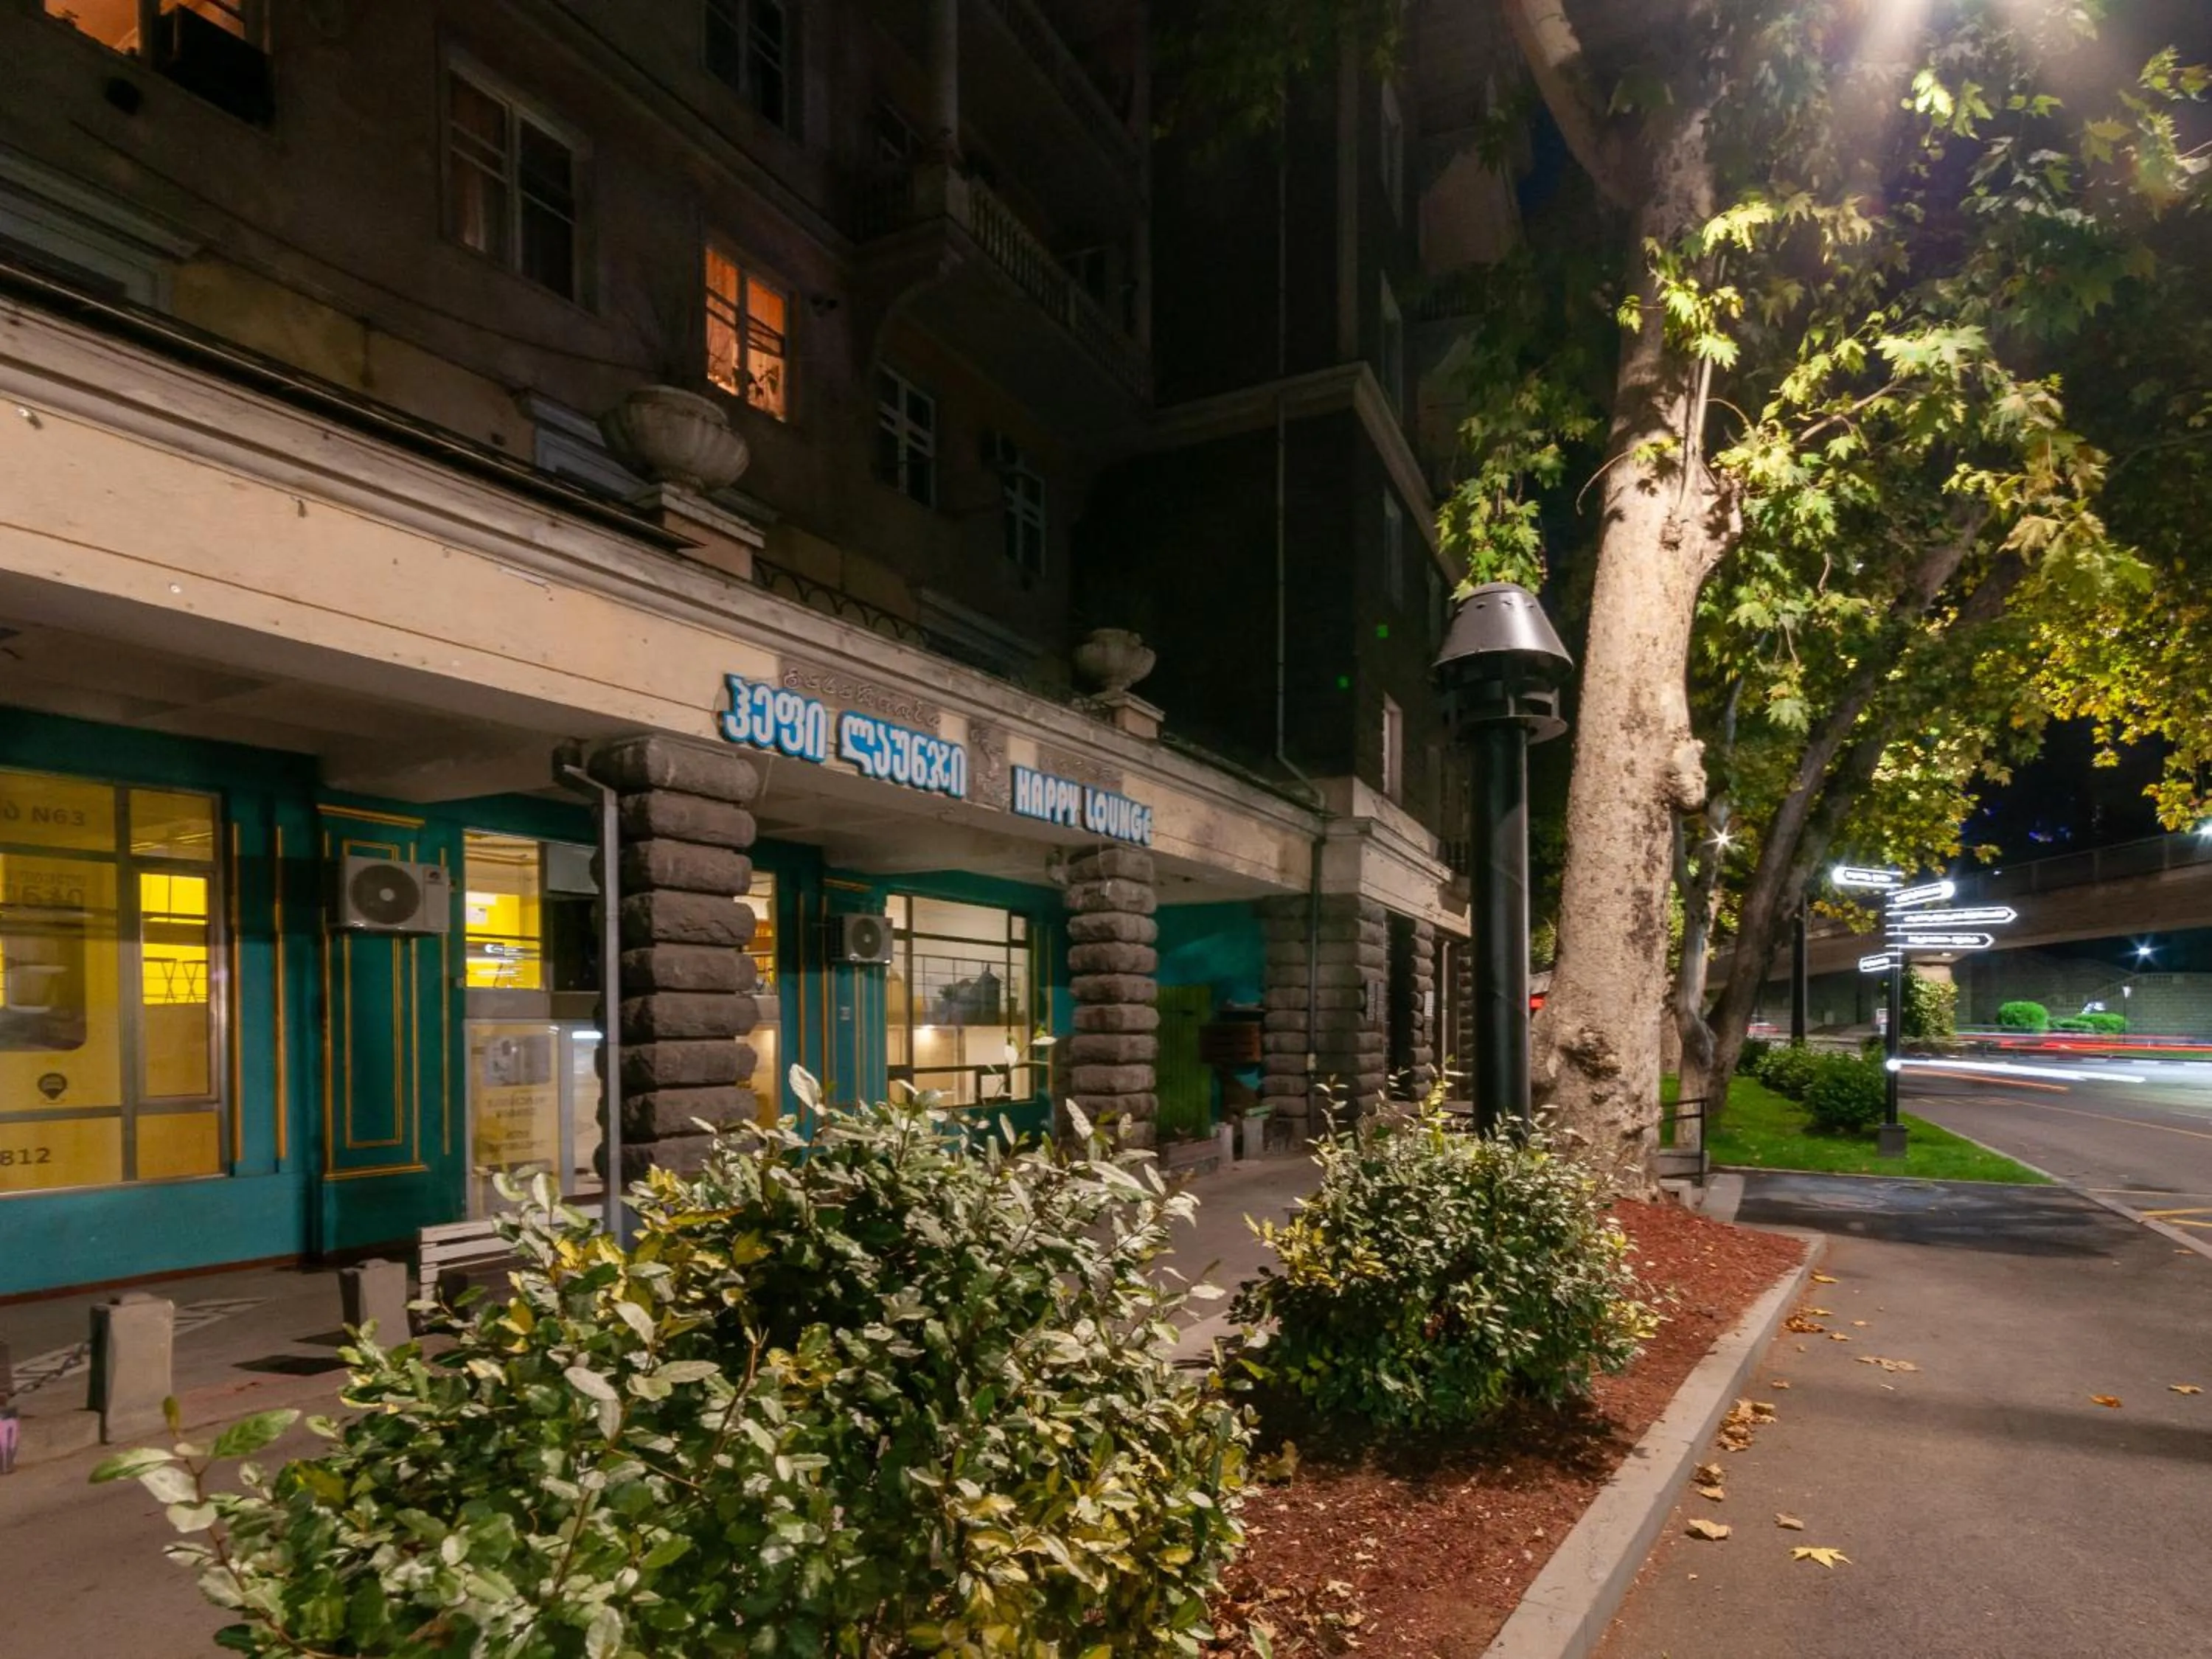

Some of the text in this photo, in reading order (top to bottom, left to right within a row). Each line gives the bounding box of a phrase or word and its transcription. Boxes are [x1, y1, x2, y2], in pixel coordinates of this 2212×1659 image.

[726, 675, 826, 759] ჰეფი
[841, 714, 967, 798] ლაუნჯი
[32, 805, 86, 827] N63
[1015, 767, 1152, 846] HAPPY LOUNGE
